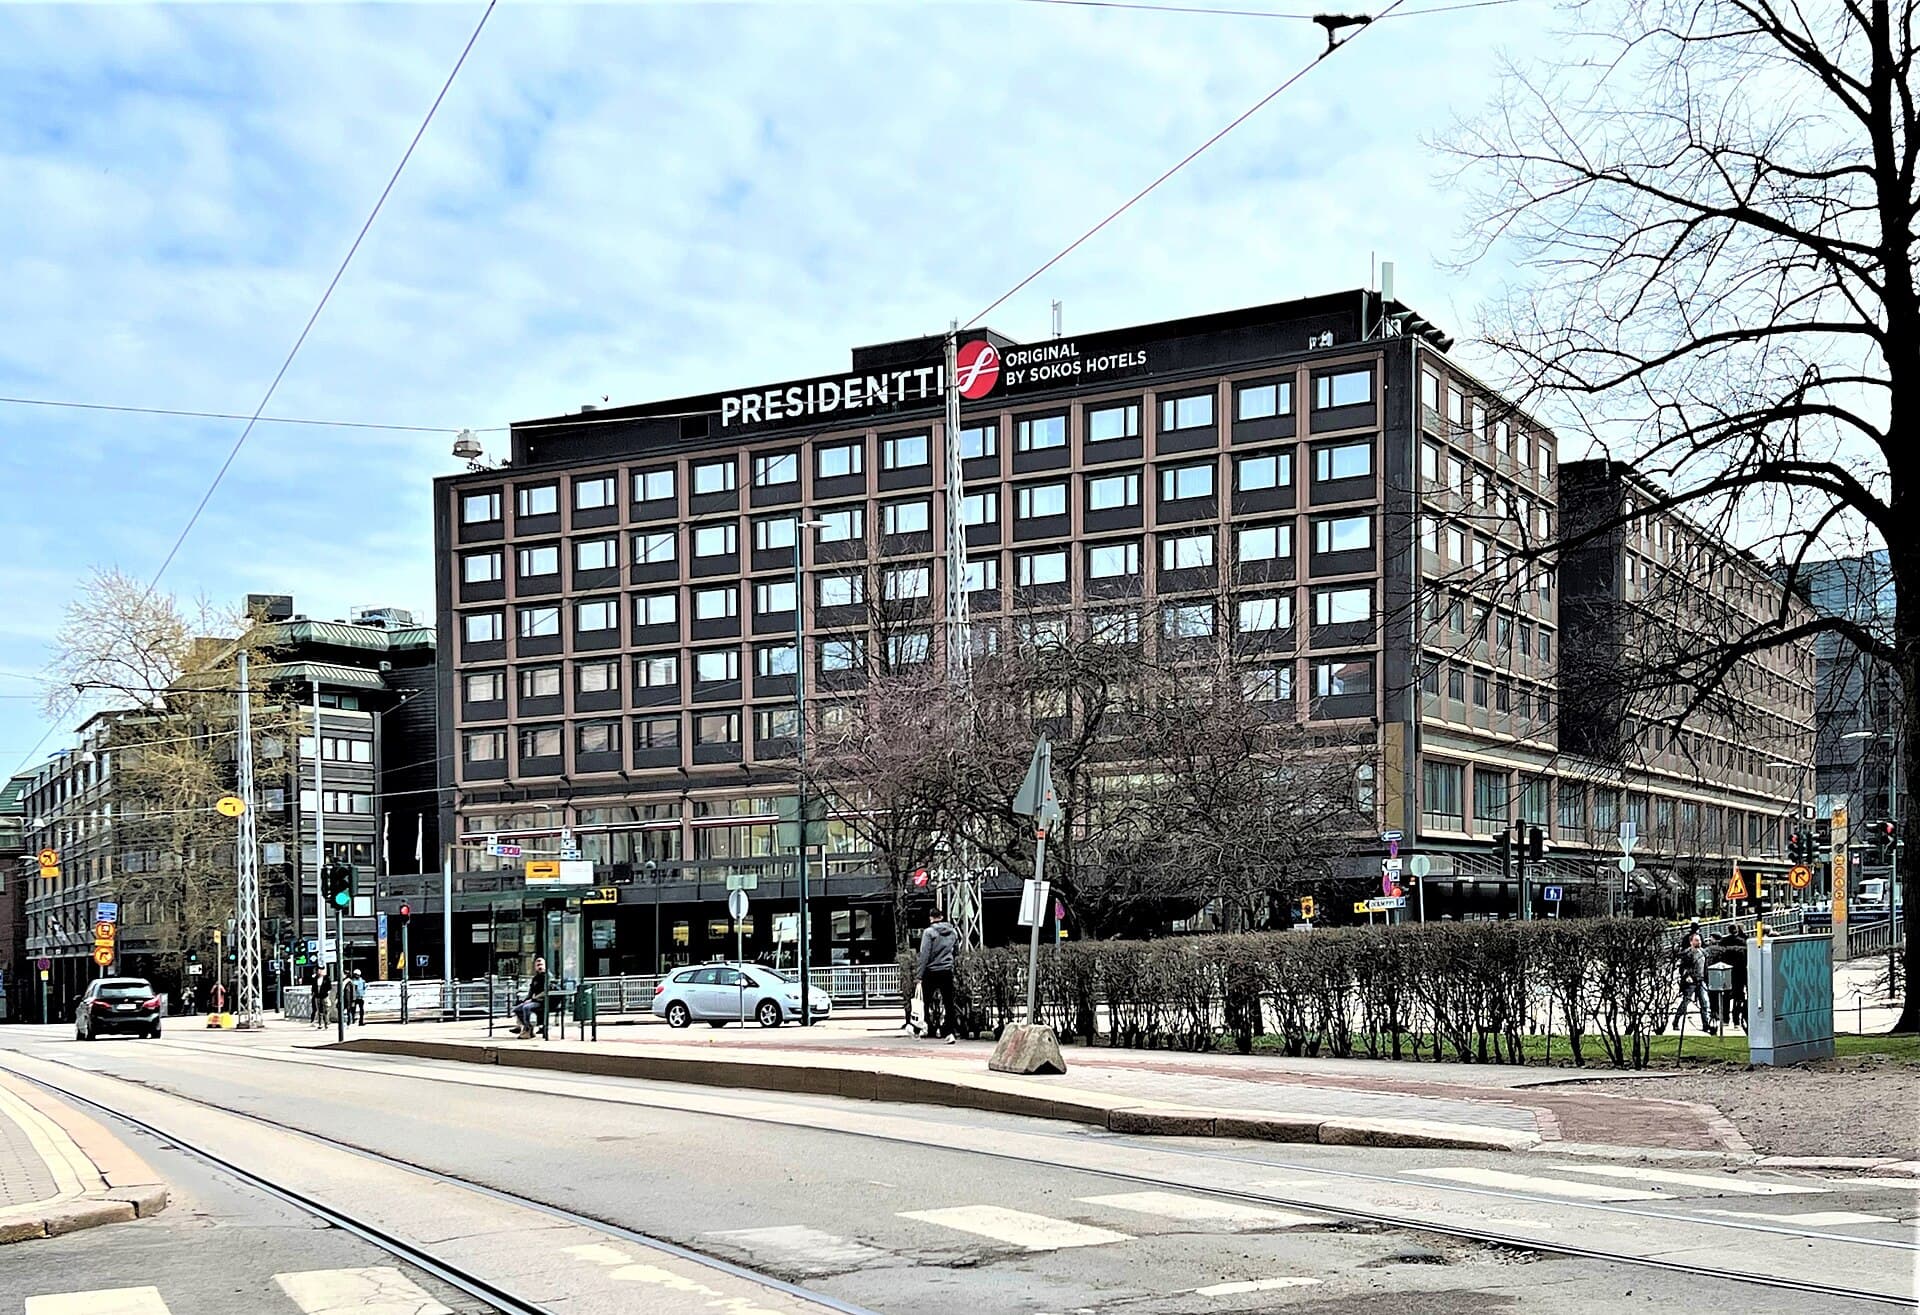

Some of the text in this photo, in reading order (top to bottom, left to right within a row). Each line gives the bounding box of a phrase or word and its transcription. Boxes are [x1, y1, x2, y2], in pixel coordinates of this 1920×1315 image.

[1005, 342, 1079, 367] ORIGINAL
[1006, 350, 1147, 386] BY SOKOS HOTELS
[721, 365, 944, 427] PRESIDENTTI
